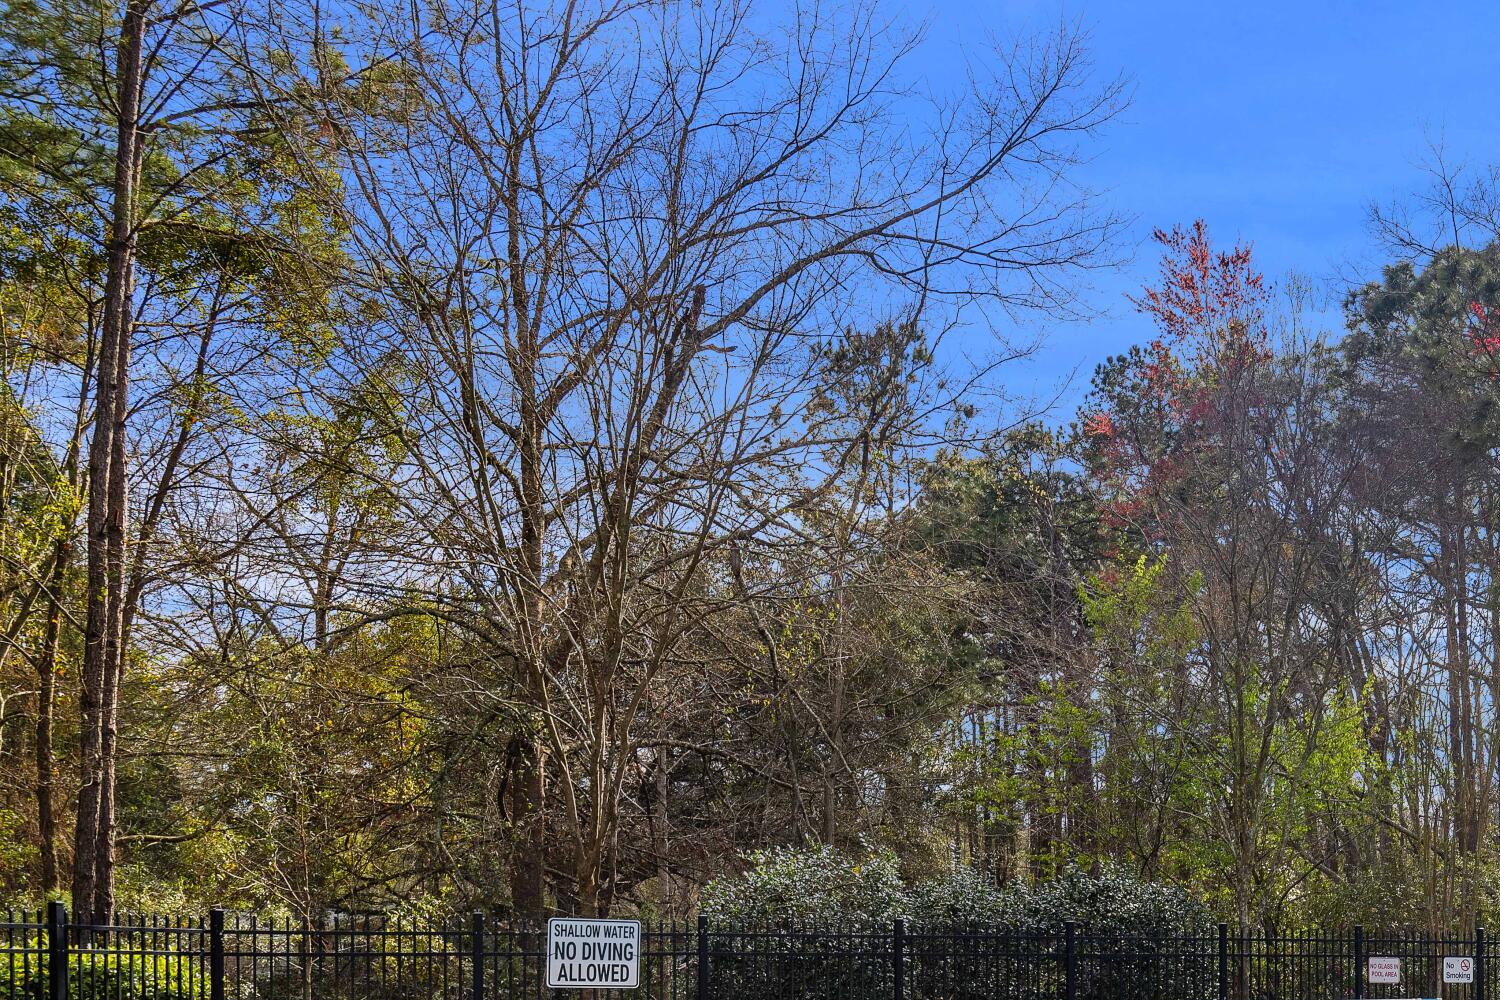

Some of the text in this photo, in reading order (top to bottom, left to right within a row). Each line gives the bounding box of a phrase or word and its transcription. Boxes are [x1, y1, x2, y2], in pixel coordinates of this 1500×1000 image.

[554, 924, 635, 939] SHALLOW WATER
[554, 941, 634, 962] NO DIVING
[557, 963, 630, 982] ALLOWED
[1446, 971, 1470, 979] Smoking
